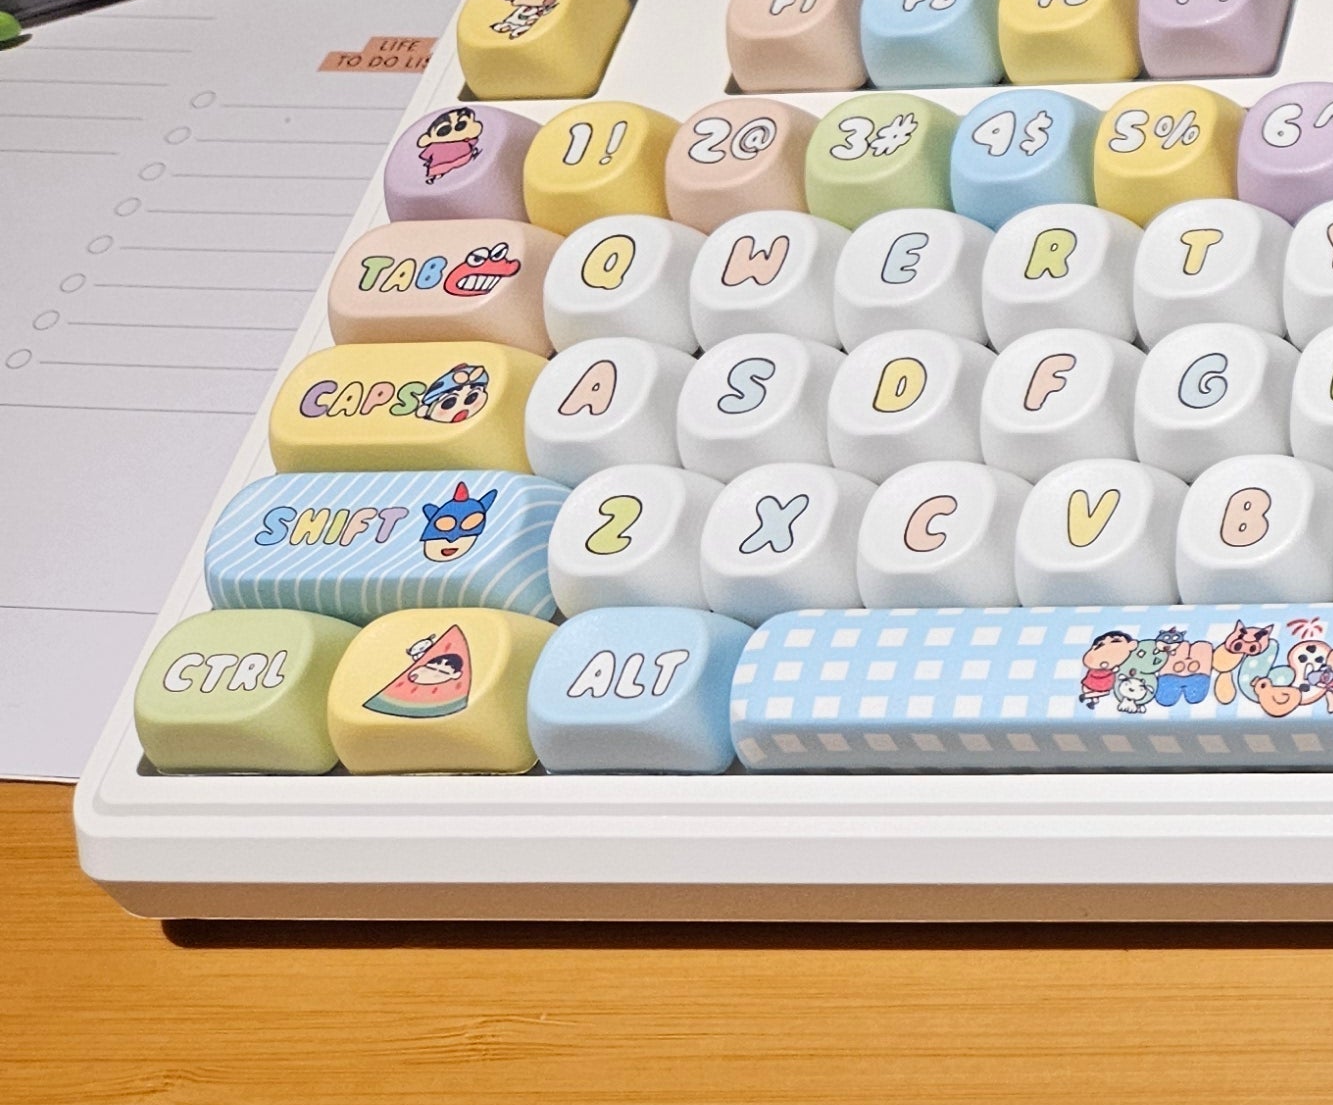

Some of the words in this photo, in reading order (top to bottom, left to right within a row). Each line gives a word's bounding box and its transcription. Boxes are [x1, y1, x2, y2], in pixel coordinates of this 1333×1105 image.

[335, 55, 363, 68] TO
[367, 55, 399, 68] DO
[404, 53, 434, 69] LIS
[380, 40, 421, 52] LIFE
[562, 121, 629, 167] 1!
[687, 116, 778, 165] 2@
[829, 110, 918, 161] 3#
[972, 109, 1053, 157] 4$
[1108, 109, 1200, 154] 5%
[357, 253, 444, 293] TAB
[581, 233, 637, 291] Q
[721, 234, 791, 287] W
[881, 232, 930, 285] E
[1024, 227, 1078, 281] R
[1180, 228, 1224, 276] T
[299, 380, 425, 418] CAPS
[558, 359, 618, 416] A
[717, 357, 777, 414] S
[872, 356, 928, 413] D
[1023, 353, 1077, 411] F
[1178, 352, 1229, 410] G
[254, 506, 409, 546] SHIFT
[584, 494, 644, 556] Z
[739, 493, 810, 555] X
[903, 495, 959, 553] C
[1066, 488, 1121, 548] V
[1220, 487, 1272, 548] B
[162, 650, 288, 693] CTRL
[566, 649, 690, 699] ALT
